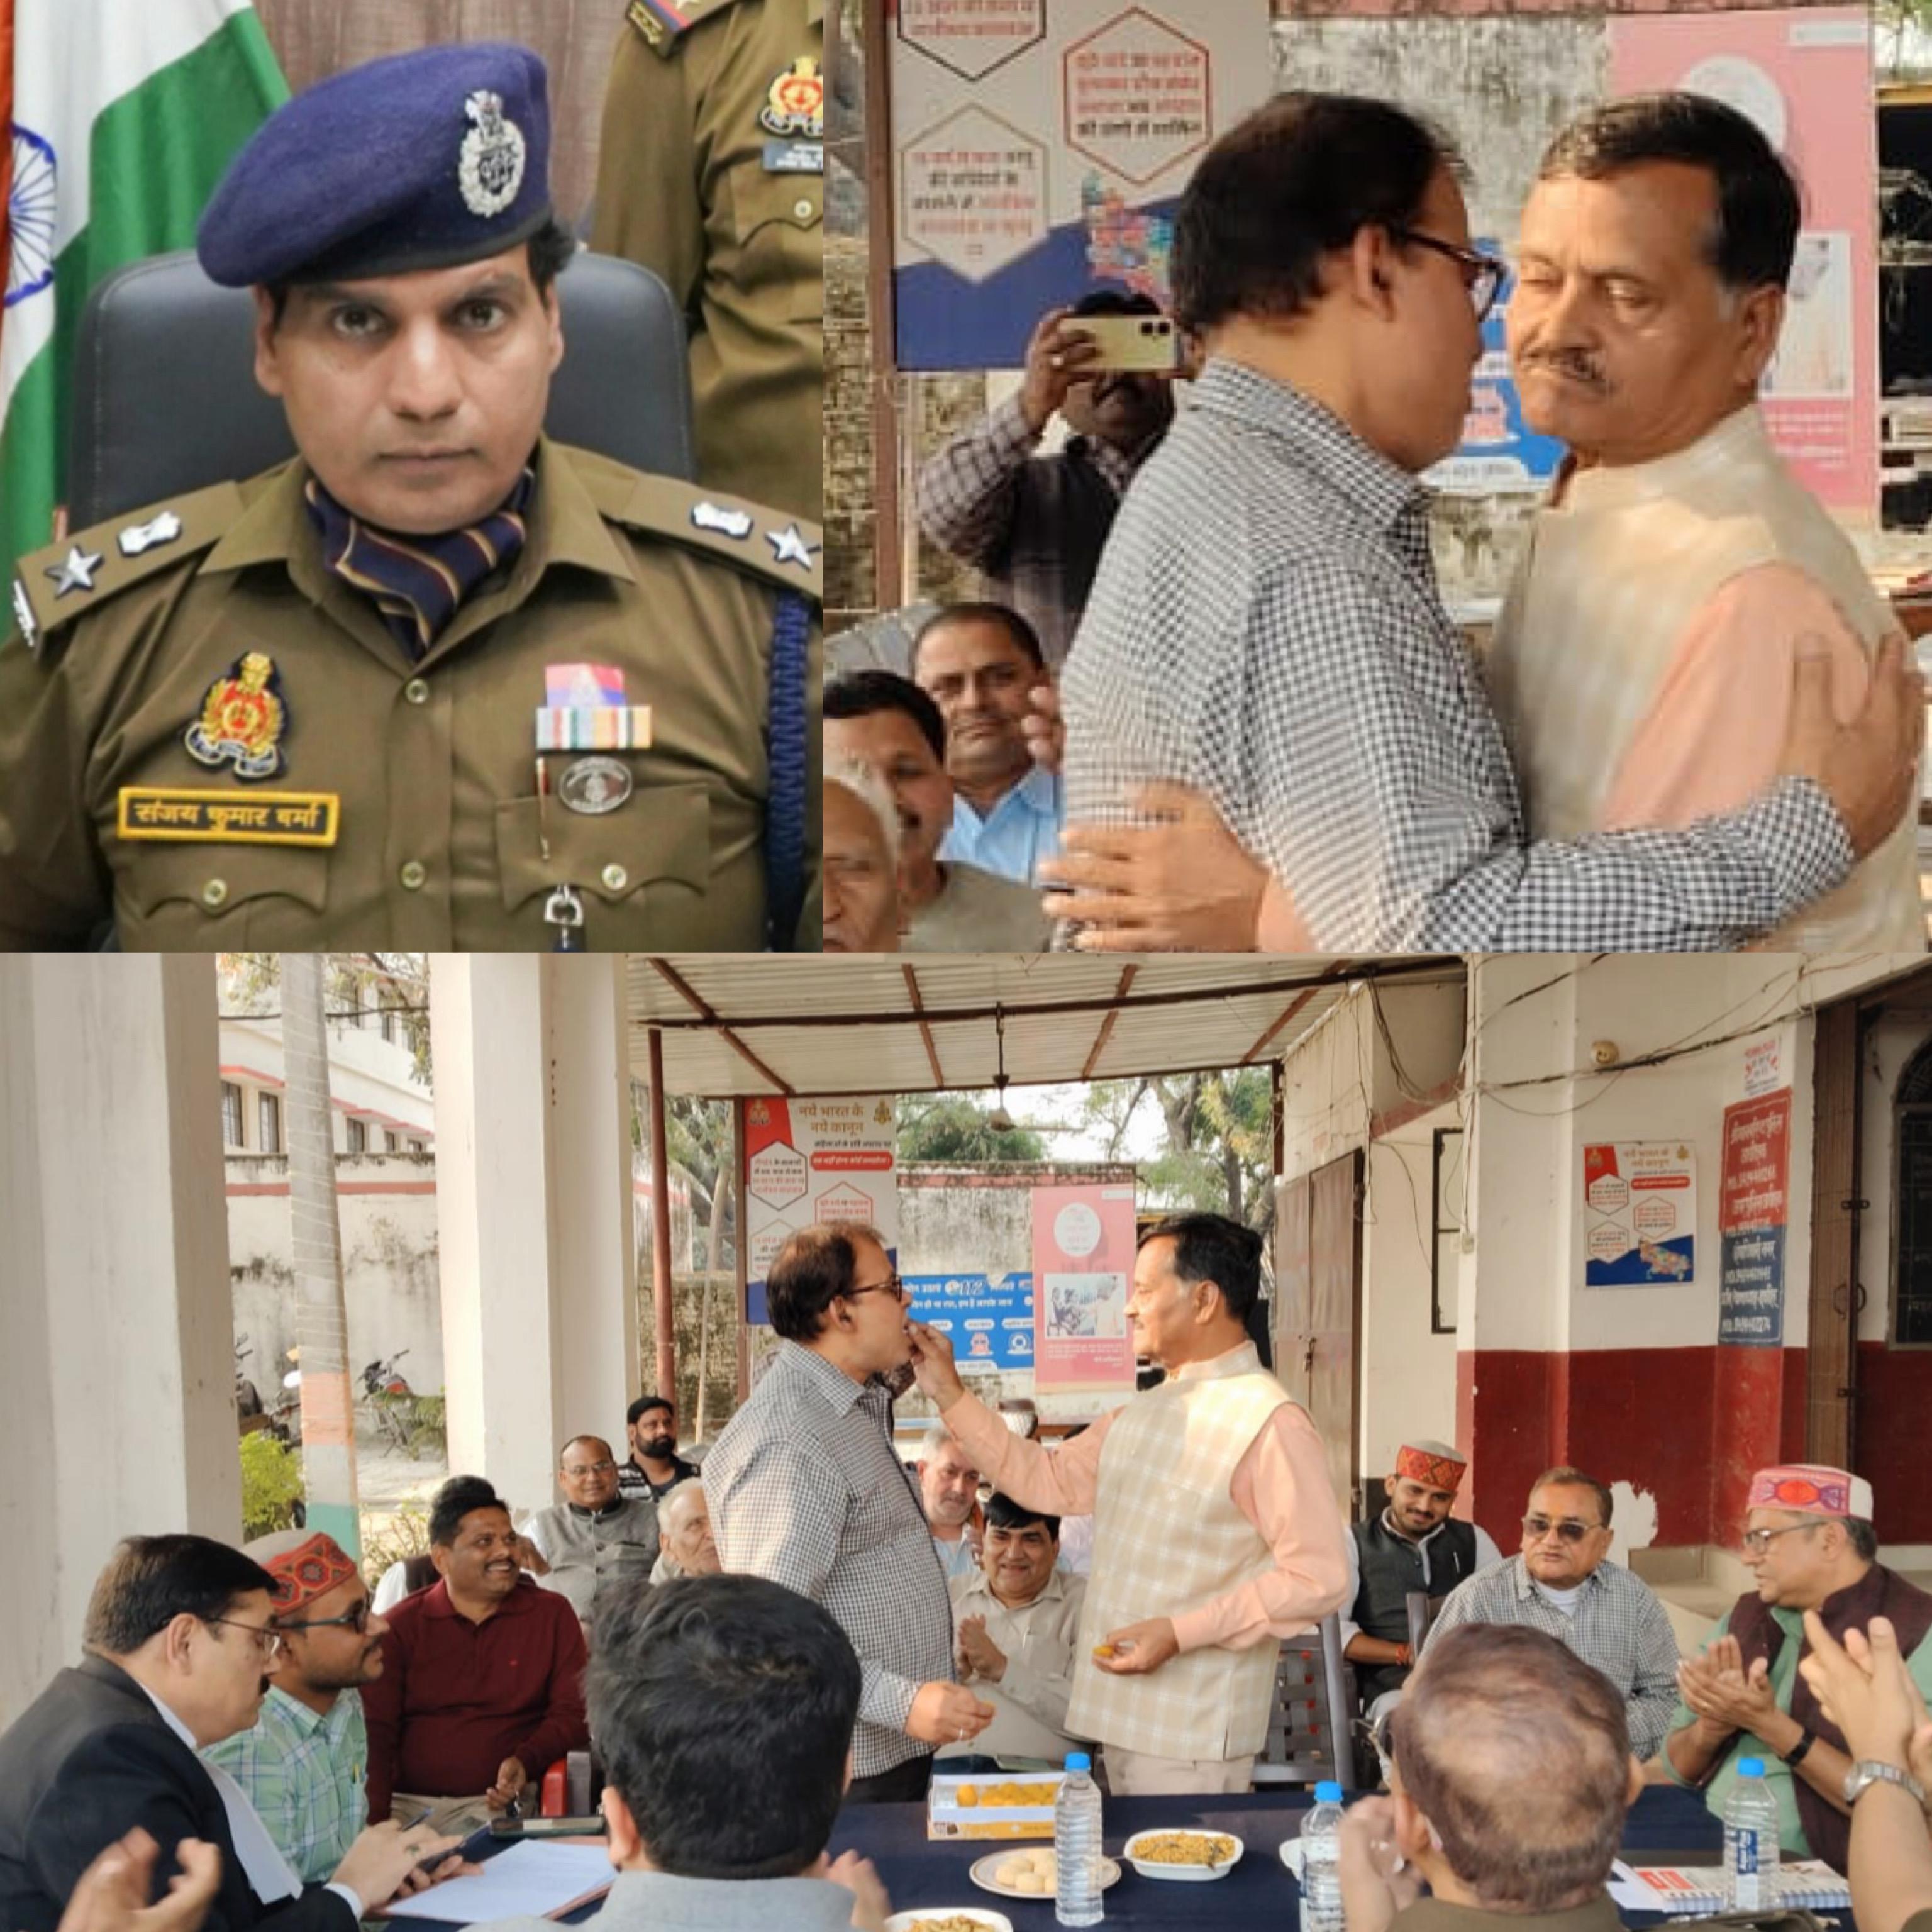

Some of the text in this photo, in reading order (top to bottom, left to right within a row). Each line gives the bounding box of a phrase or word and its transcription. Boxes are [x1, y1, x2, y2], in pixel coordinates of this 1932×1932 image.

[134, 798, 201, 825] संजय
[206, 806, 270, 832] कुमार
[820, 1106, 849, 1117] भारत
[852, 1102, 864, 1117] के
[831, 1121, 864, 1136] कानून
